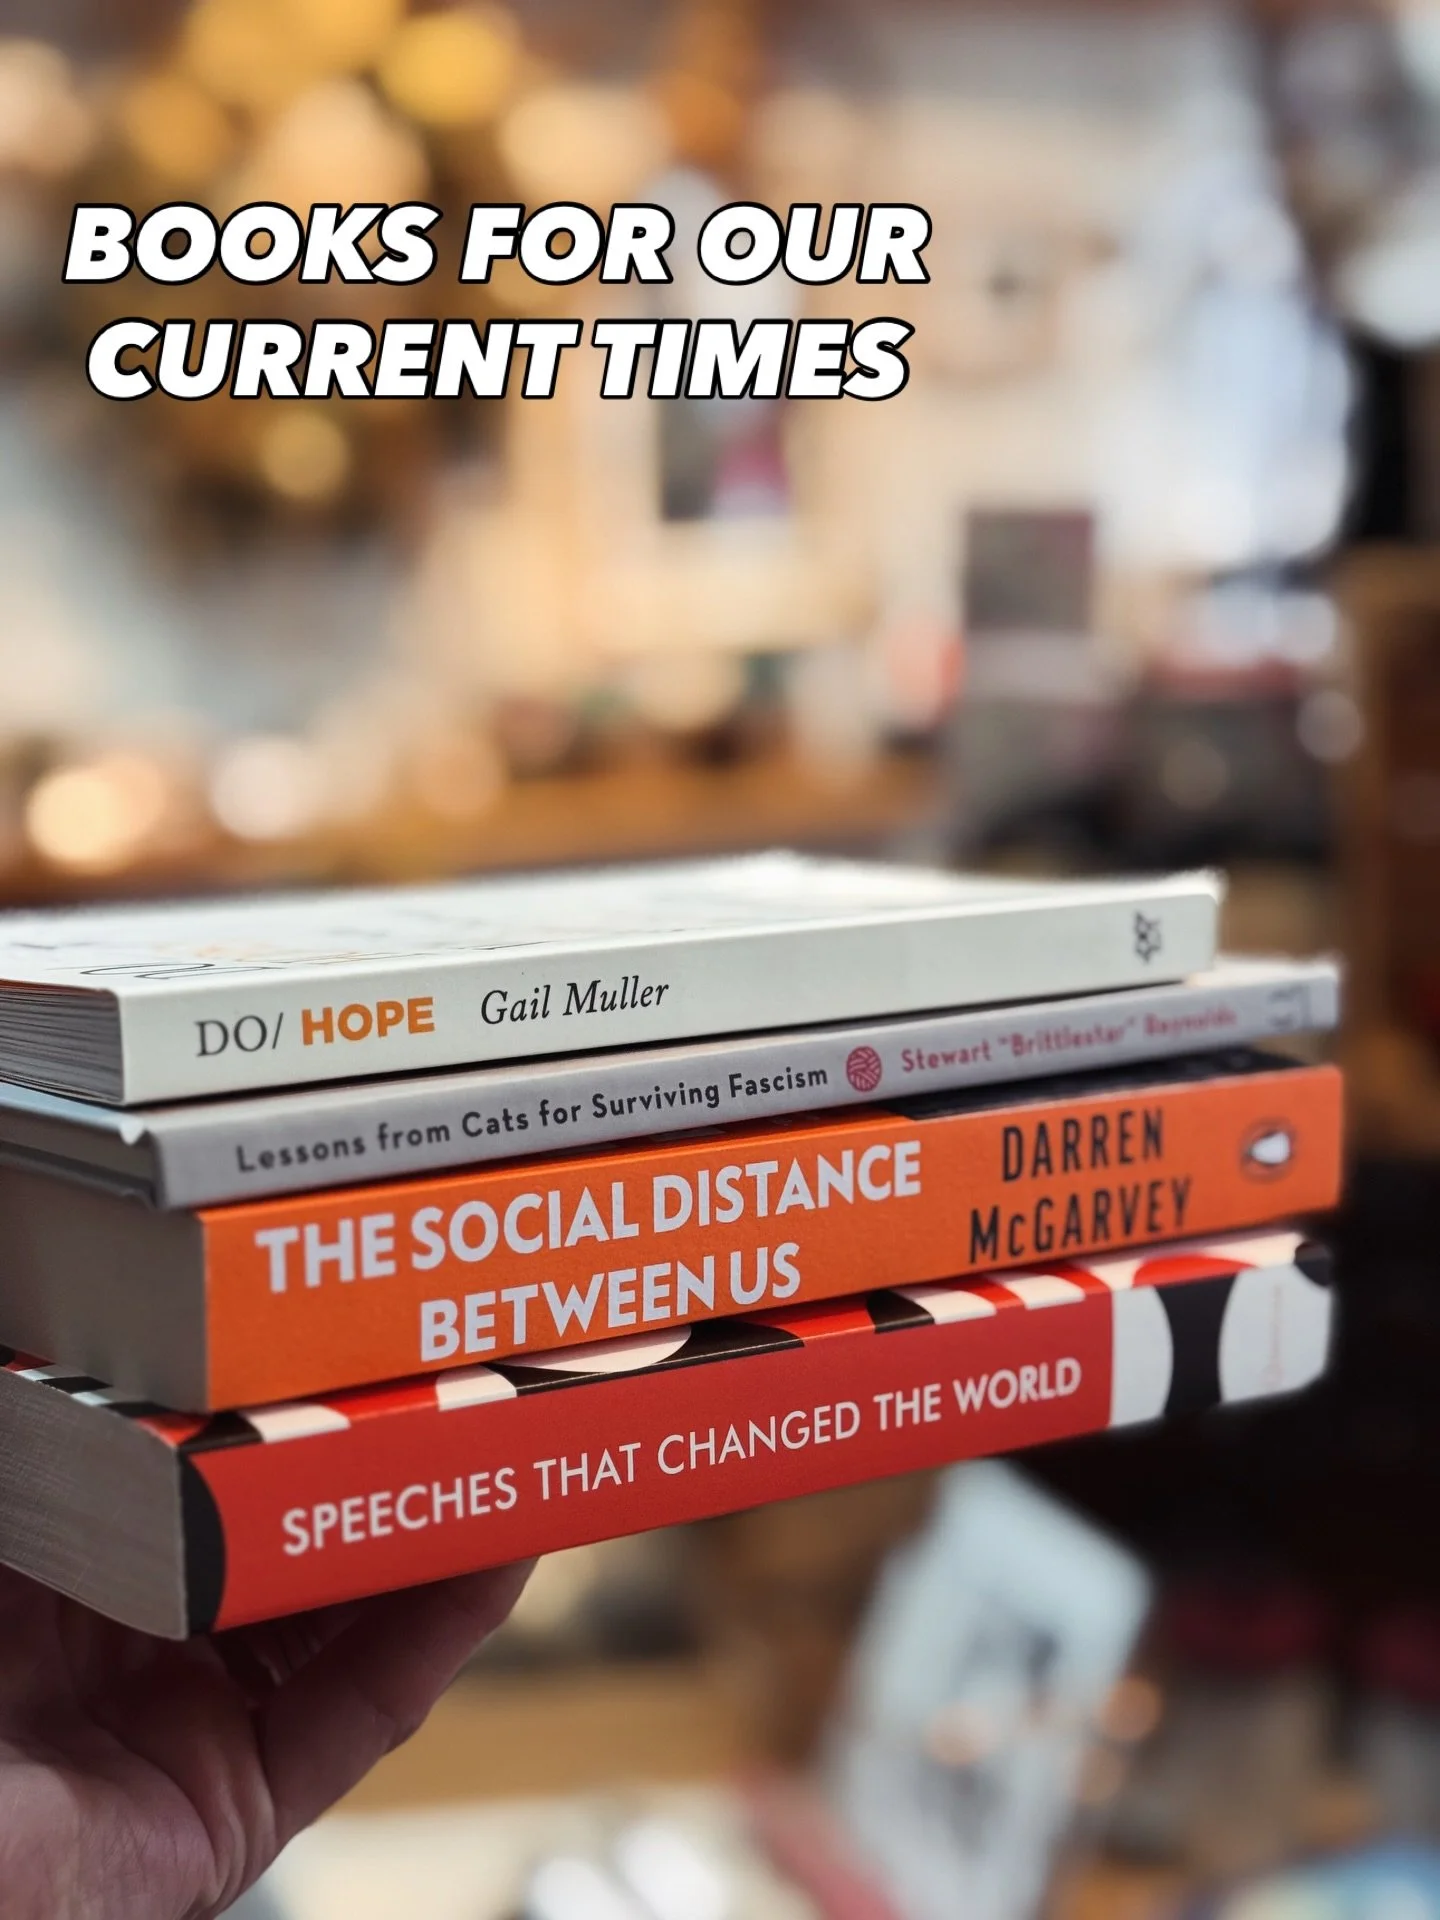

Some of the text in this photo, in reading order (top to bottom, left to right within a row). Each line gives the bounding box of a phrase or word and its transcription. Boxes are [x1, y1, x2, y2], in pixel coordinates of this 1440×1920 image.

[195, 976, 670, 1057] DO/ HOPE Gail Muller
[901, 1040, 993, 1074] Stewart
[236, 1065, 829, 1173] Lessons from Cats for Surviving Fascism
[1001, 1106, 1164, 1183] DARREN
[255, 1140, 922, 1294] THE SOCIAL DISTANCE
[968, 1176, 1194, 1266] McGARVEY
[419, 1242, 802, 1364] BETWEEN US
[282, 1356, 1083, 1558] SPEECHES THAT CHANGED THE WORLD
